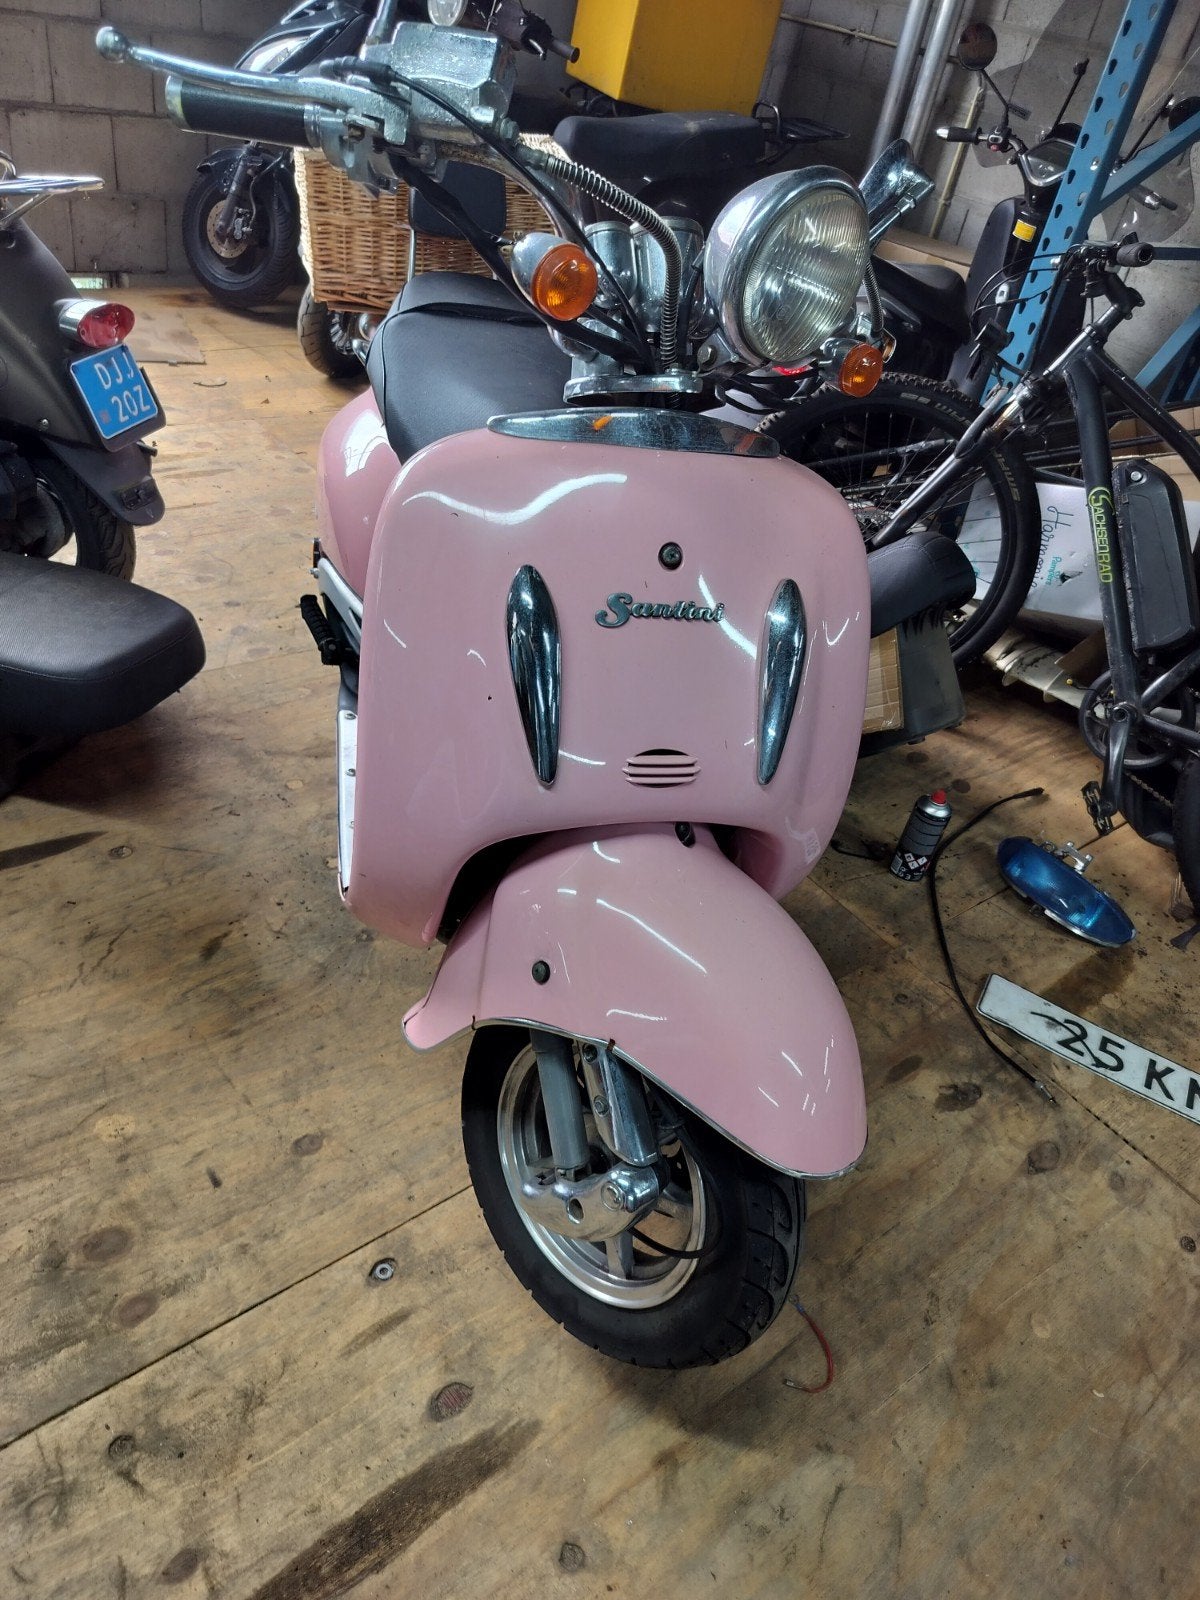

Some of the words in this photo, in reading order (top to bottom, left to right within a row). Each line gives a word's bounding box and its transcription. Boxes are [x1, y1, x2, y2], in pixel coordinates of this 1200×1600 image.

[94, 352, 135, 390] DJJ
[111, 385, 150, 423] 20Z
[1088, 486, 1115, 584] SACHSENRAD
[594, 592, 725, 629] Santini
[1057, 1018, 1126, 1072] 25
